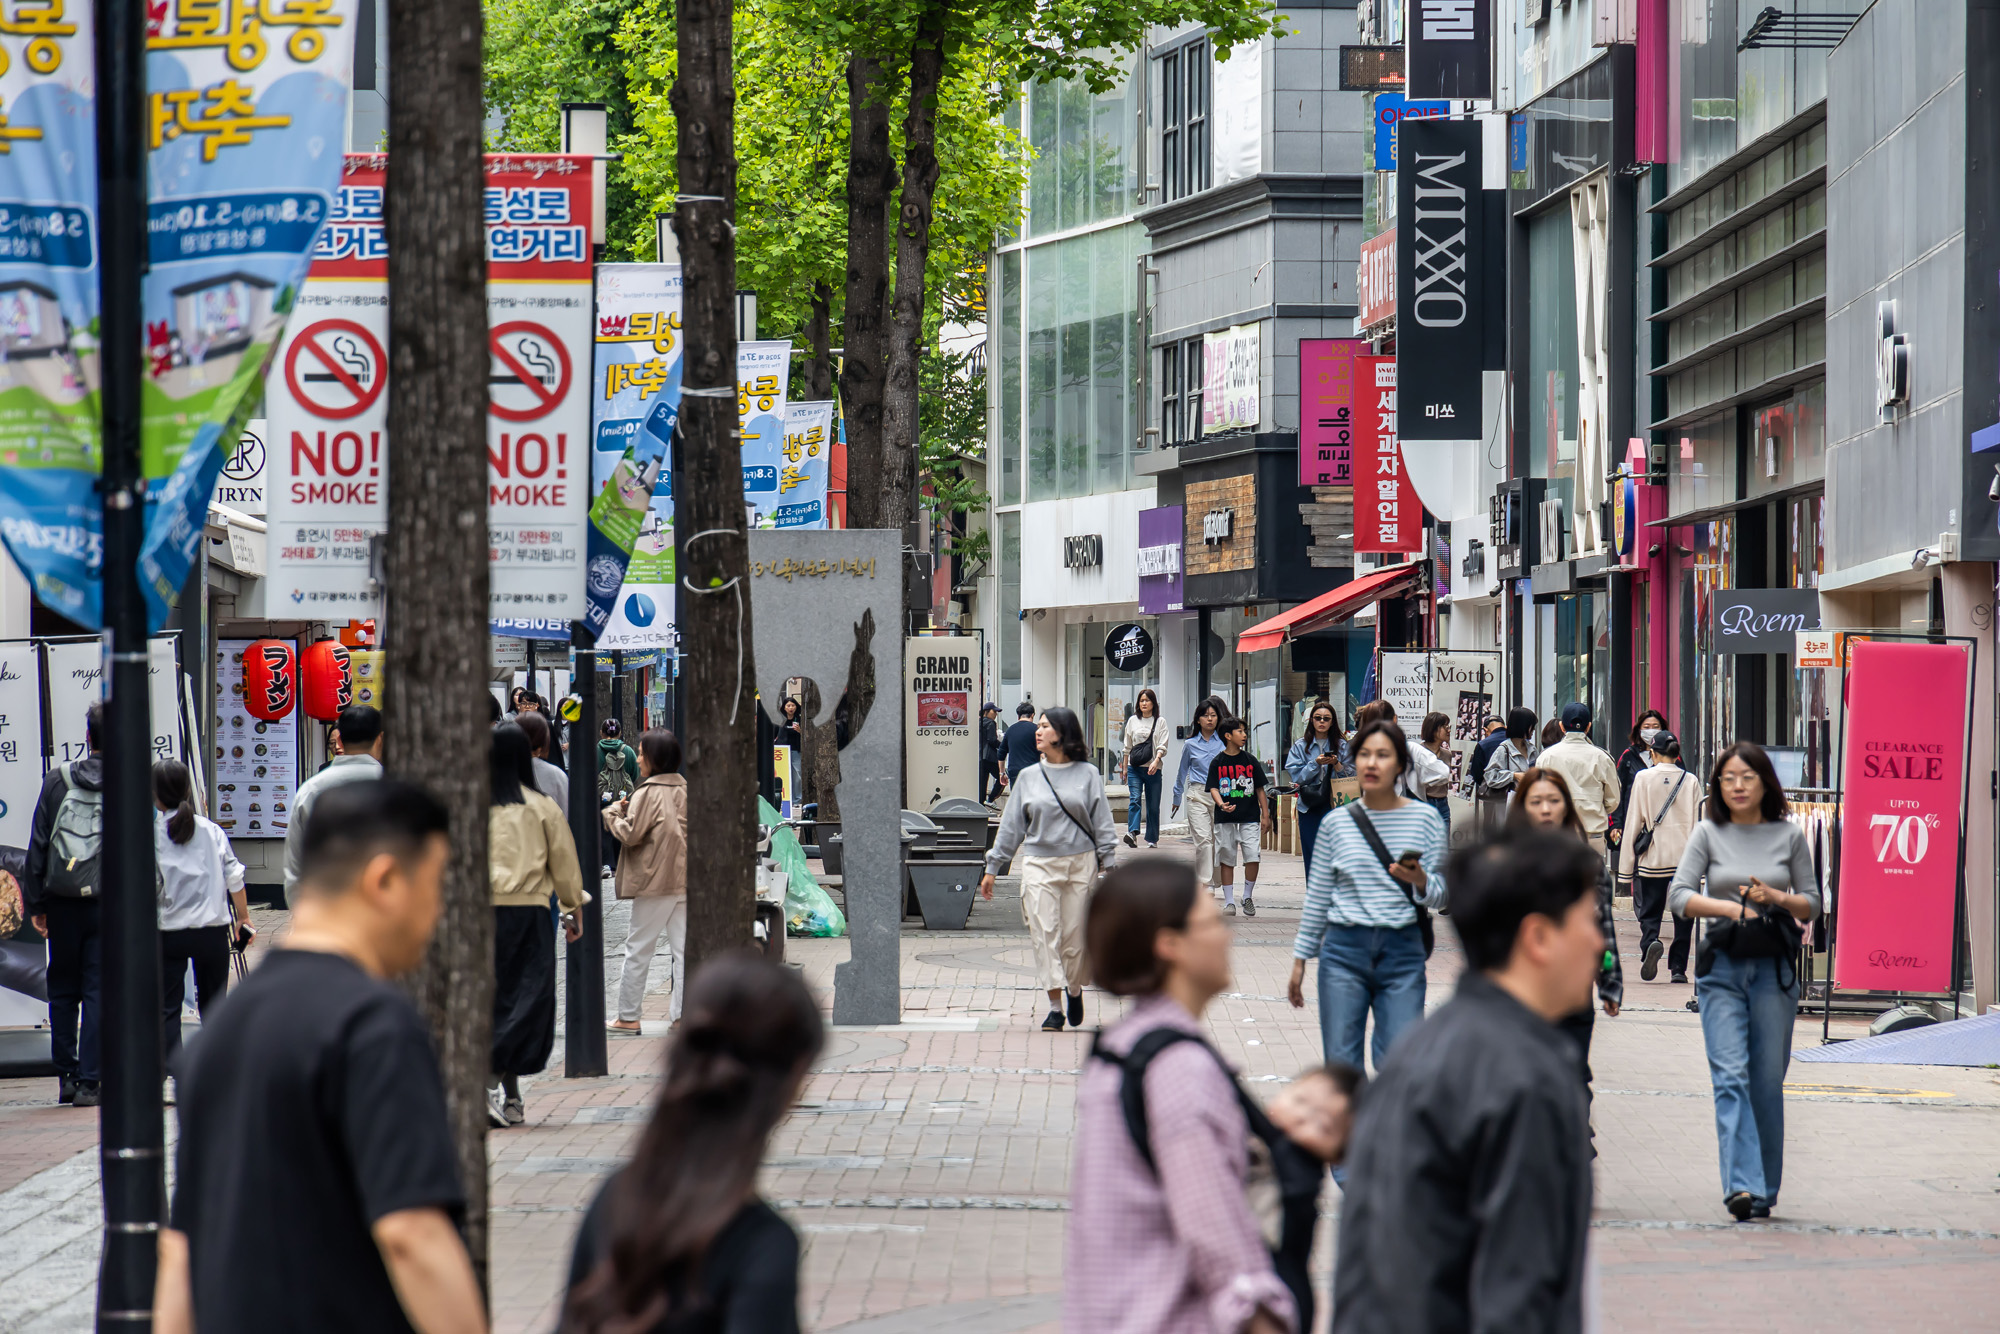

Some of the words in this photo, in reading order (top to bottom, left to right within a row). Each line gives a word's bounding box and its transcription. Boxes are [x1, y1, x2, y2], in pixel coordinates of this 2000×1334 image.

[1414, 150, 1467, 328] MIXXO
[290, 430, 381, 477] NO!
[487, 433, 568, 480] NO!
[217, 487, 263, 504] JRYN
[290, 482, 379, 505] SMOKE
[1719, 604, 1822, 638] Roem
[1114, 645, 1144, 659] BERRY
[1119, 639, 1138, 650] OAK
[916, 656, 970, 675] GRAND
[263, 646, 290, 714] ラーメン
[913, 677, 973, 692] OPENING
[1398, 700, 1426, 709] SALE
[916, 727, 931, 737] do
[933, 727, 969, 737] coffee
[932, 739, 953, 747] daegu
[1864, 741, 1944, 755] CLEARANCE
[937, 765, 950, 774] 2F
[1863, 754, 1944, 781] SALE
[1890, 800, 1904, 809] UP
[1904, 800, 1920, 809] TO
[1868, 813, 1941, 864] 70%
[1868, 949, 1928, 969] Roem
